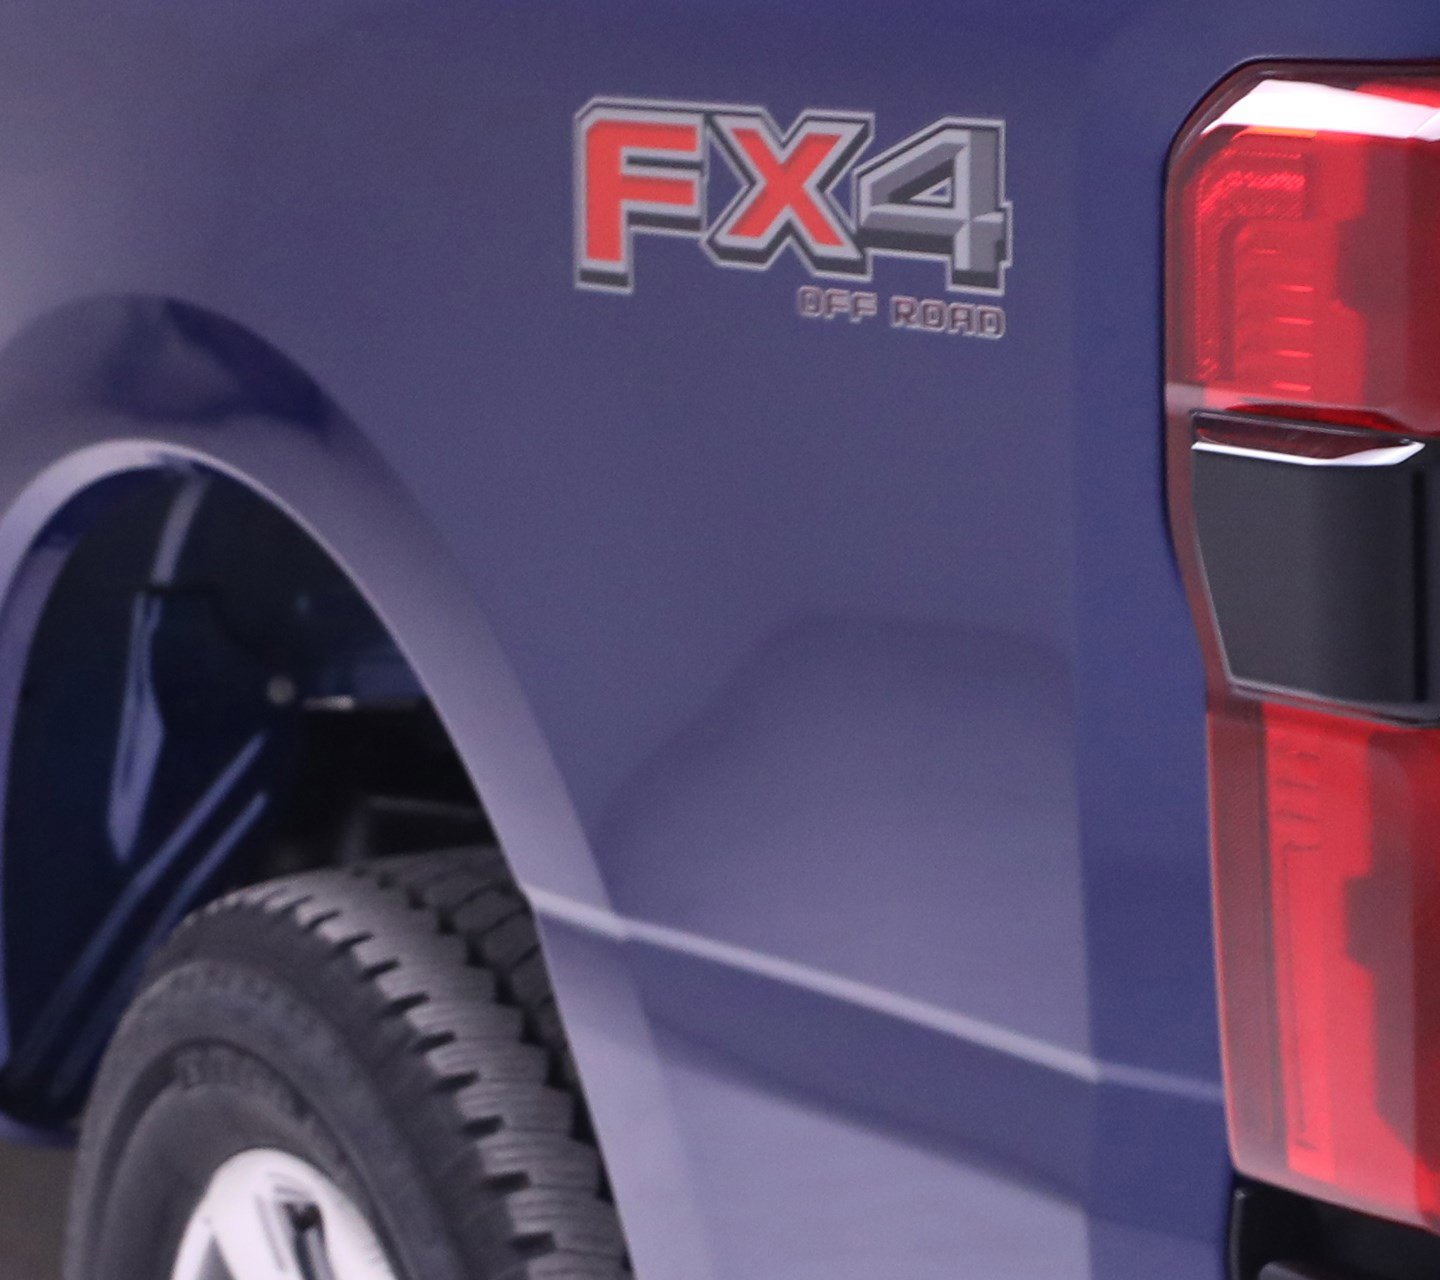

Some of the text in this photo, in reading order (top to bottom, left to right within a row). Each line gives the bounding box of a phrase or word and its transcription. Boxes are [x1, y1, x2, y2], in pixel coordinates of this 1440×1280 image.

[574, 97, 1013, 295] FX4
[797, 286, 1006, 339] OFF ROAD
